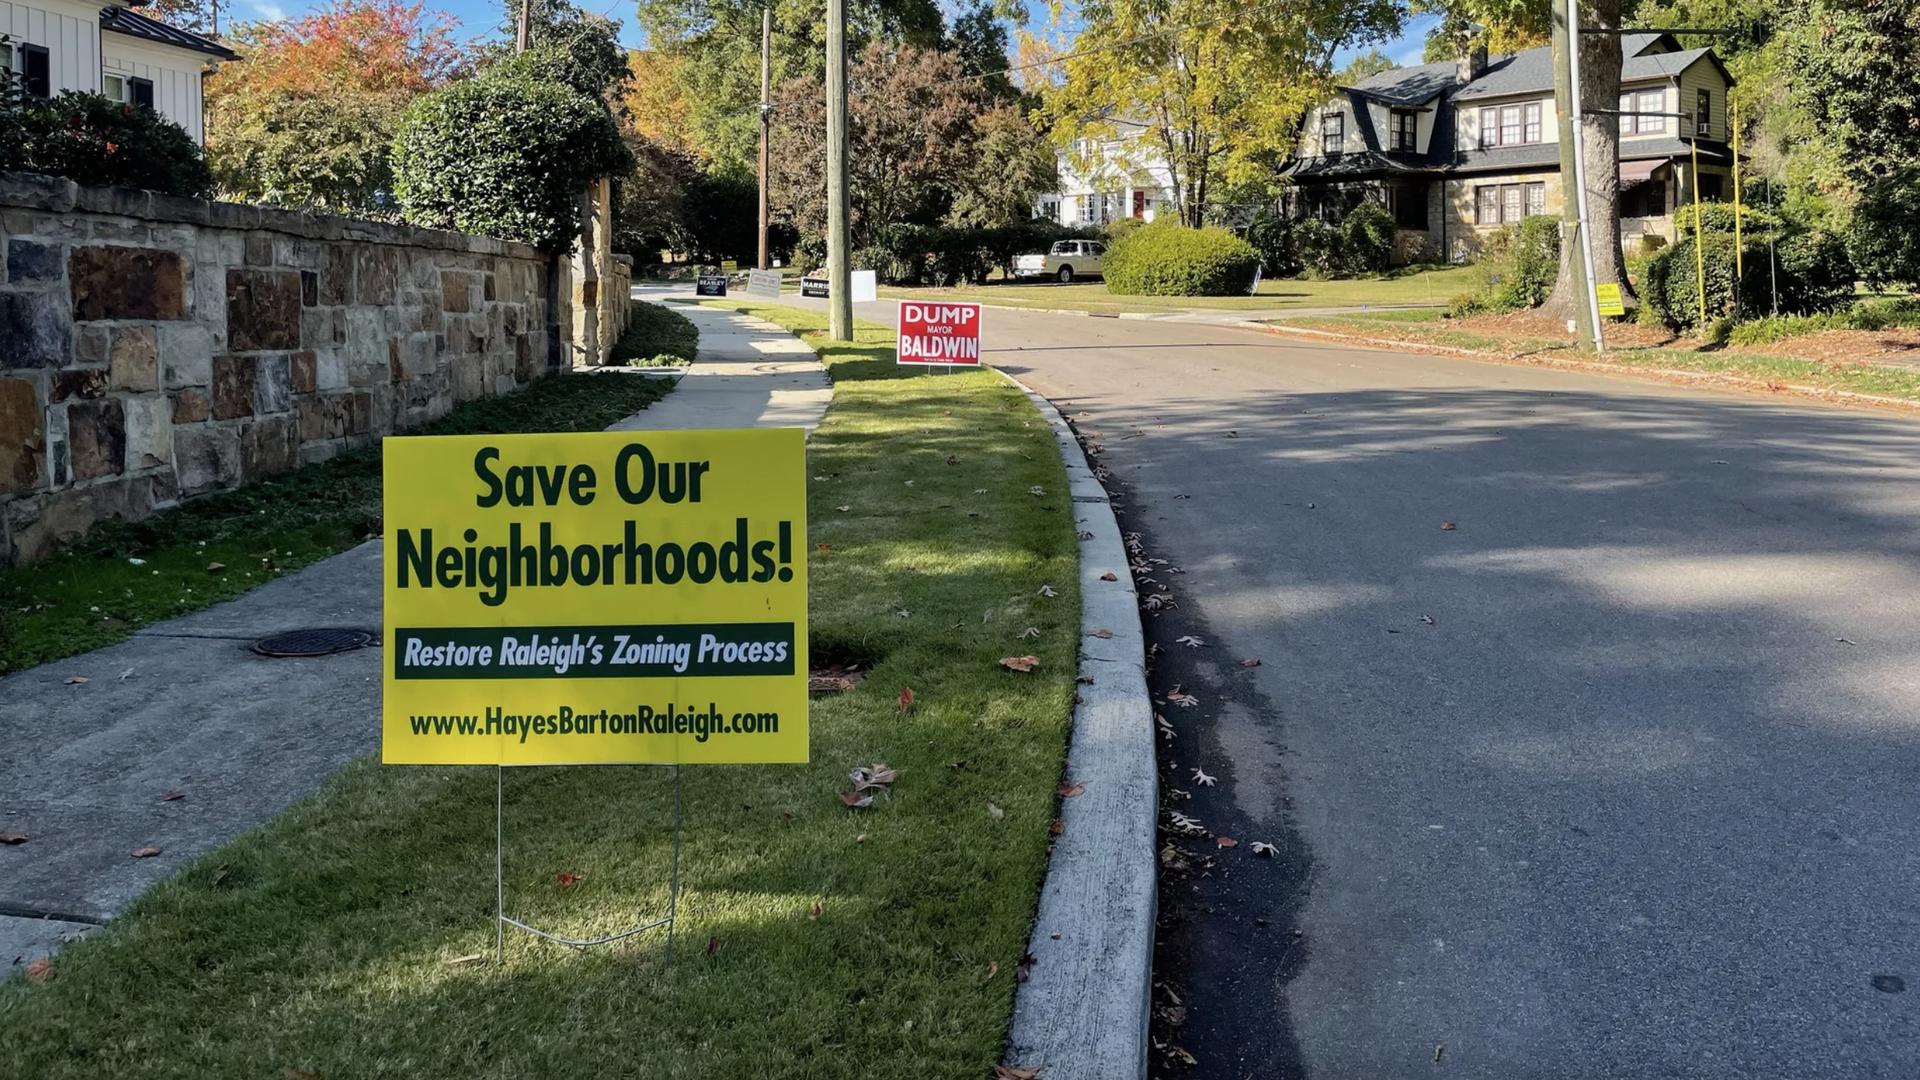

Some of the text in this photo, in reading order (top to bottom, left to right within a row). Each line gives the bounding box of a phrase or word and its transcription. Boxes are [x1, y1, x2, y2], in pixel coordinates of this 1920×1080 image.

[905, 305, 975, 325] DUMP
[926, 325, 953, 334] MAYOR
[901, 335, 977, 359] BALDWIN
[474, 443, 710, 508] Save Our
[397, 517, 794, 607] Neighborhoods!
[403, 633, 789, 674] Restore Raleigh's Zoning Process
[409, 702, 779, 744] www.HayesBartonRaleigh.com
